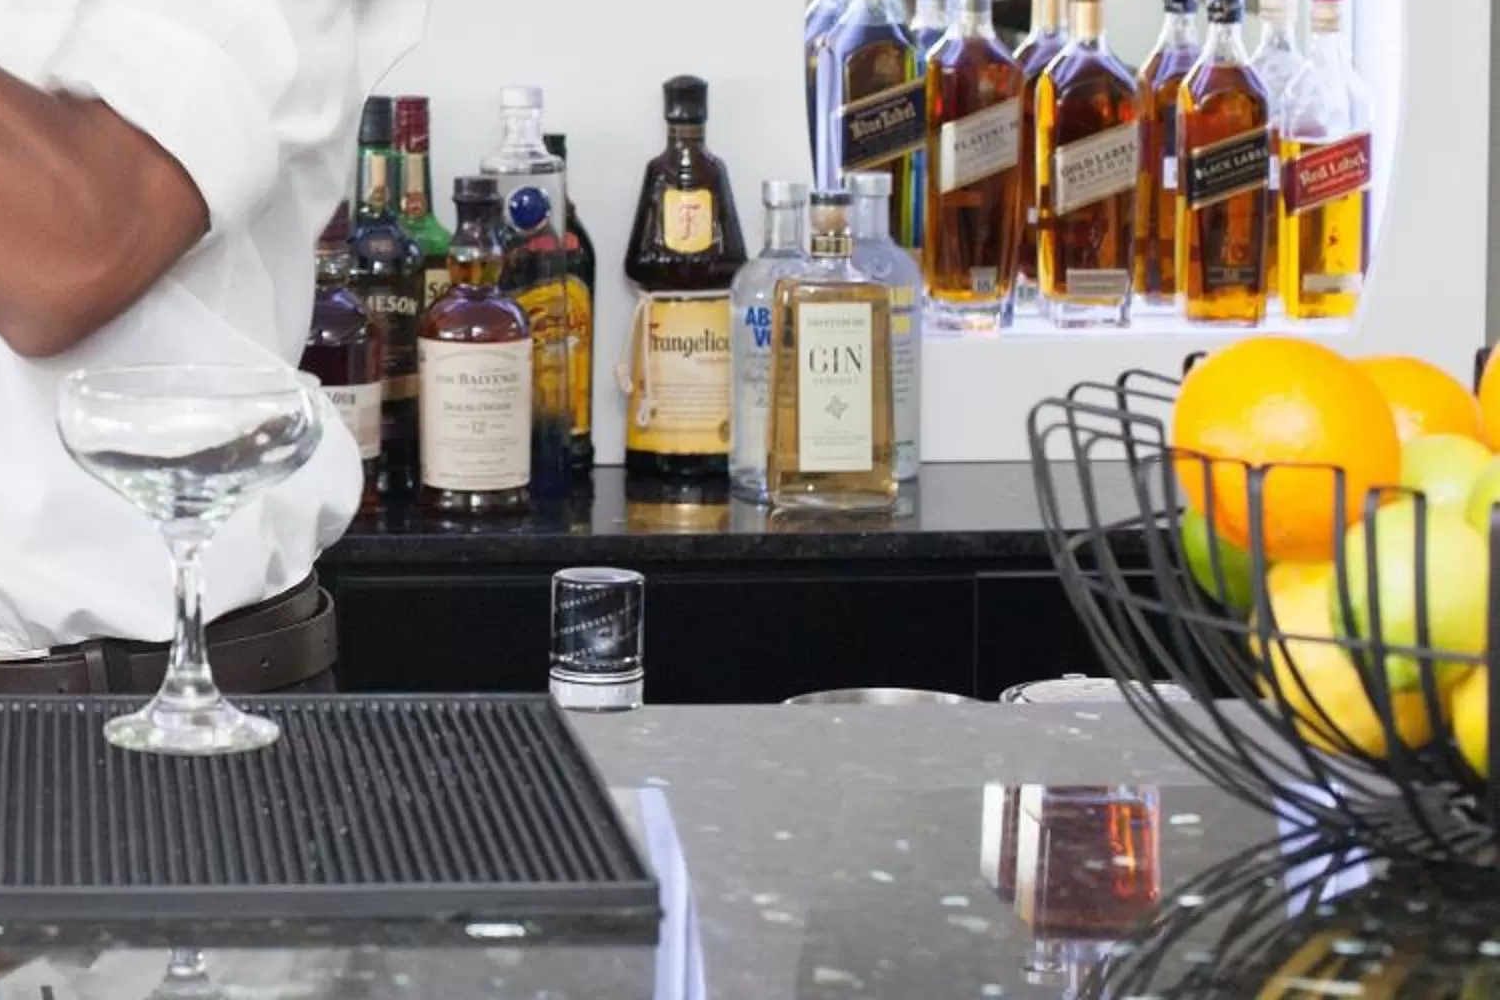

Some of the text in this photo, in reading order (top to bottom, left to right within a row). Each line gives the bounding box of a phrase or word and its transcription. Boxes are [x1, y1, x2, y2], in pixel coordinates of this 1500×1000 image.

[1194, 147, 1268, 180] BLACK LABEL
[1301, 151, 1367, 187] Red Label
[809, 342, 864, 374] GIN
[459, 372, 517, 385] BALVENIE
